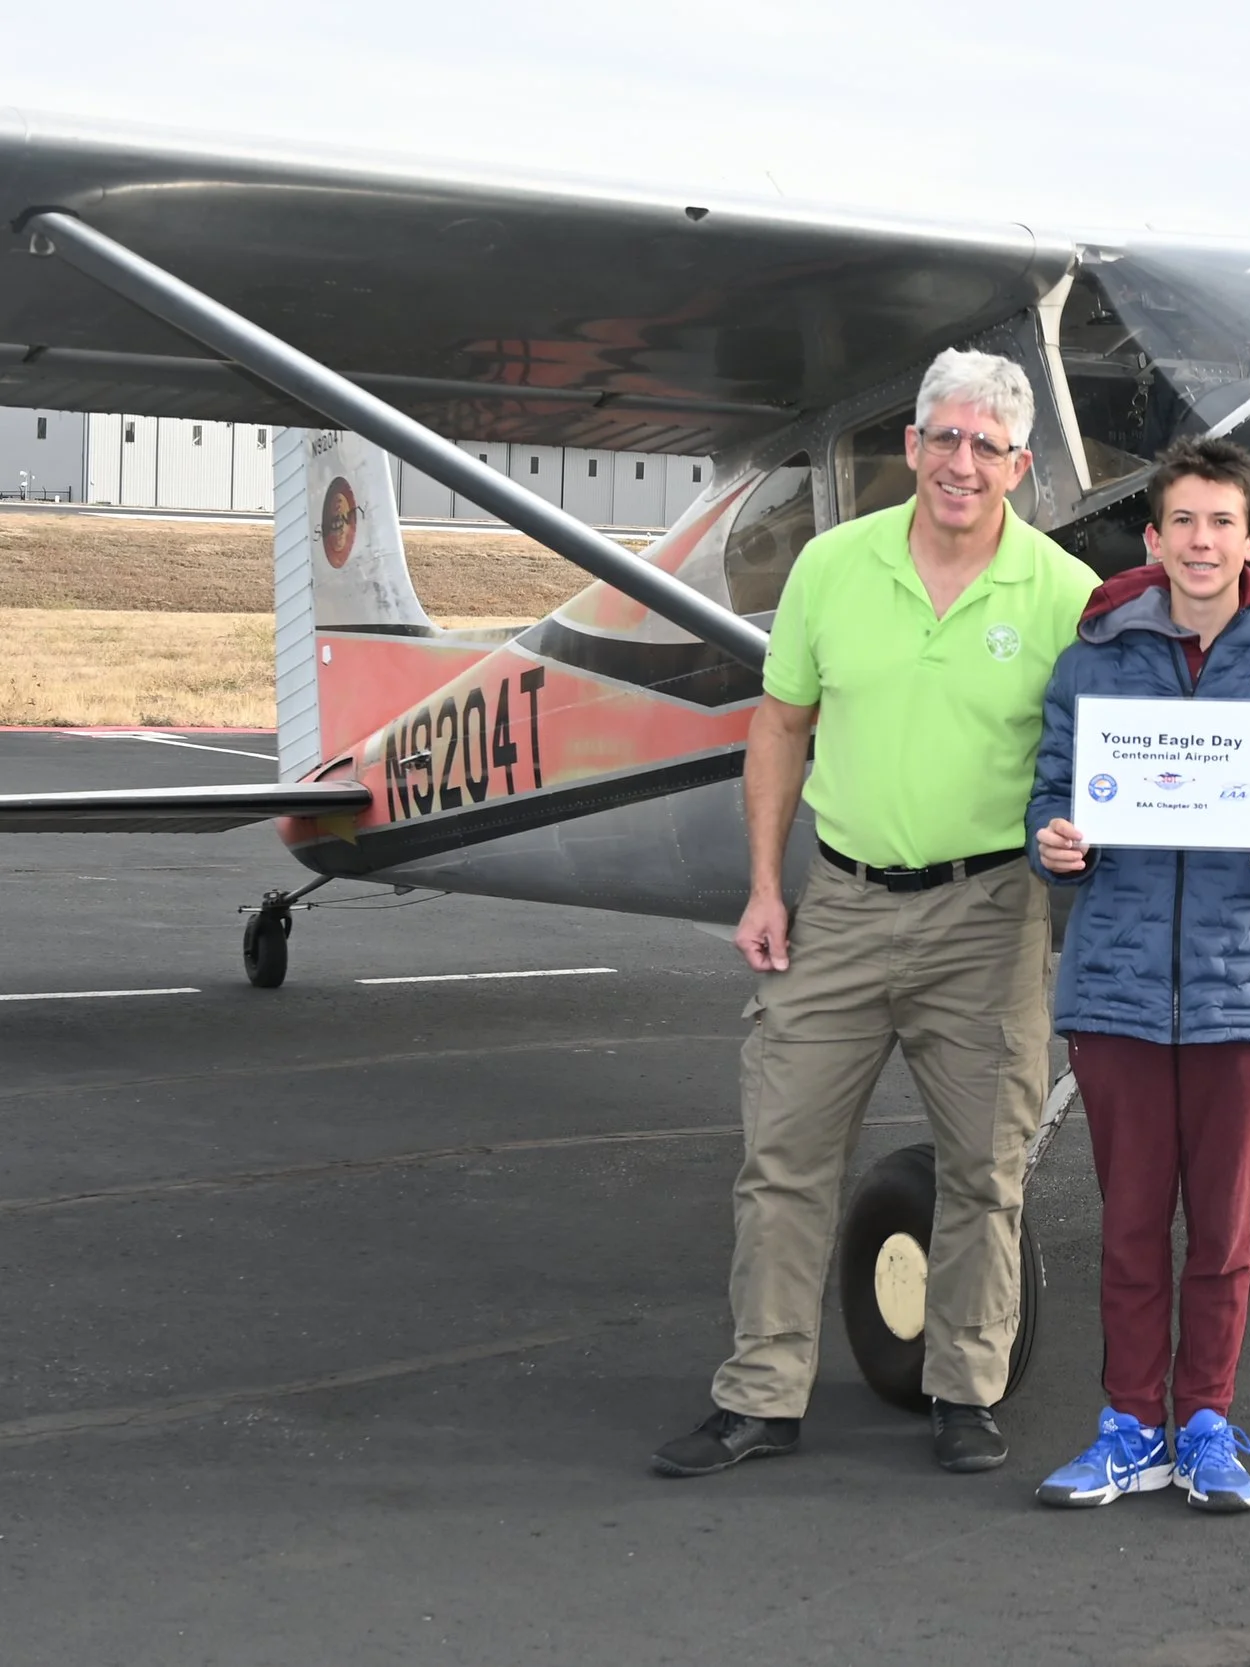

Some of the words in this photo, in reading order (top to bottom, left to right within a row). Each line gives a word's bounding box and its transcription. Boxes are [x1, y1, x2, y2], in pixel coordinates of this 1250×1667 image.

[385, 666, 545, 822] N9204T
[1101, 732, 1151, 748] Young
[1158, 734, 1205, 749] Eagle
[1211, 735, 1243, 751] Day
[1112, 750, 1181, 760] Centennial
[1185, 752, 1229, 763] Airport
[1136, 801, 1154, 809] EAA
[1156, 802, 1190, 811] Chapter
